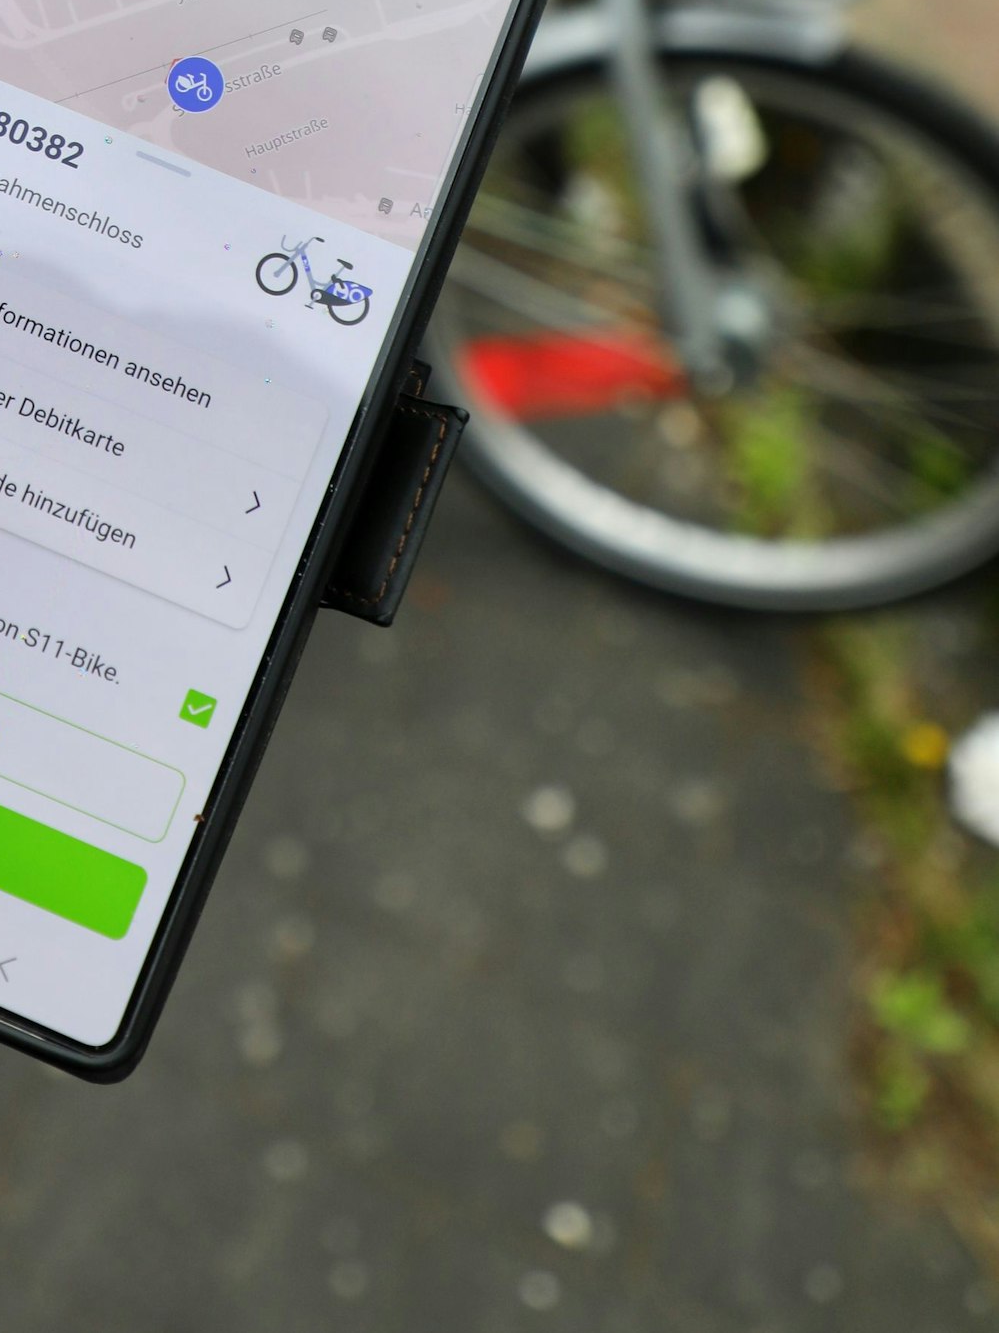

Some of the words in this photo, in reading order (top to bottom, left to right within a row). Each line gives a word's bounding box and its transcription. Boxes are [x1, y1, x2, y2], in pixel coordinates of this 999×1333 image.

[244, 117, 329, 159] Hauptstraße
[124, 360, 212, 409] ansehen
[18, 397, 126, 457] Debitkarte
[20, 483, 137, 549] hinzufügen
[23, 628, 122, 686] S11-Bike.
